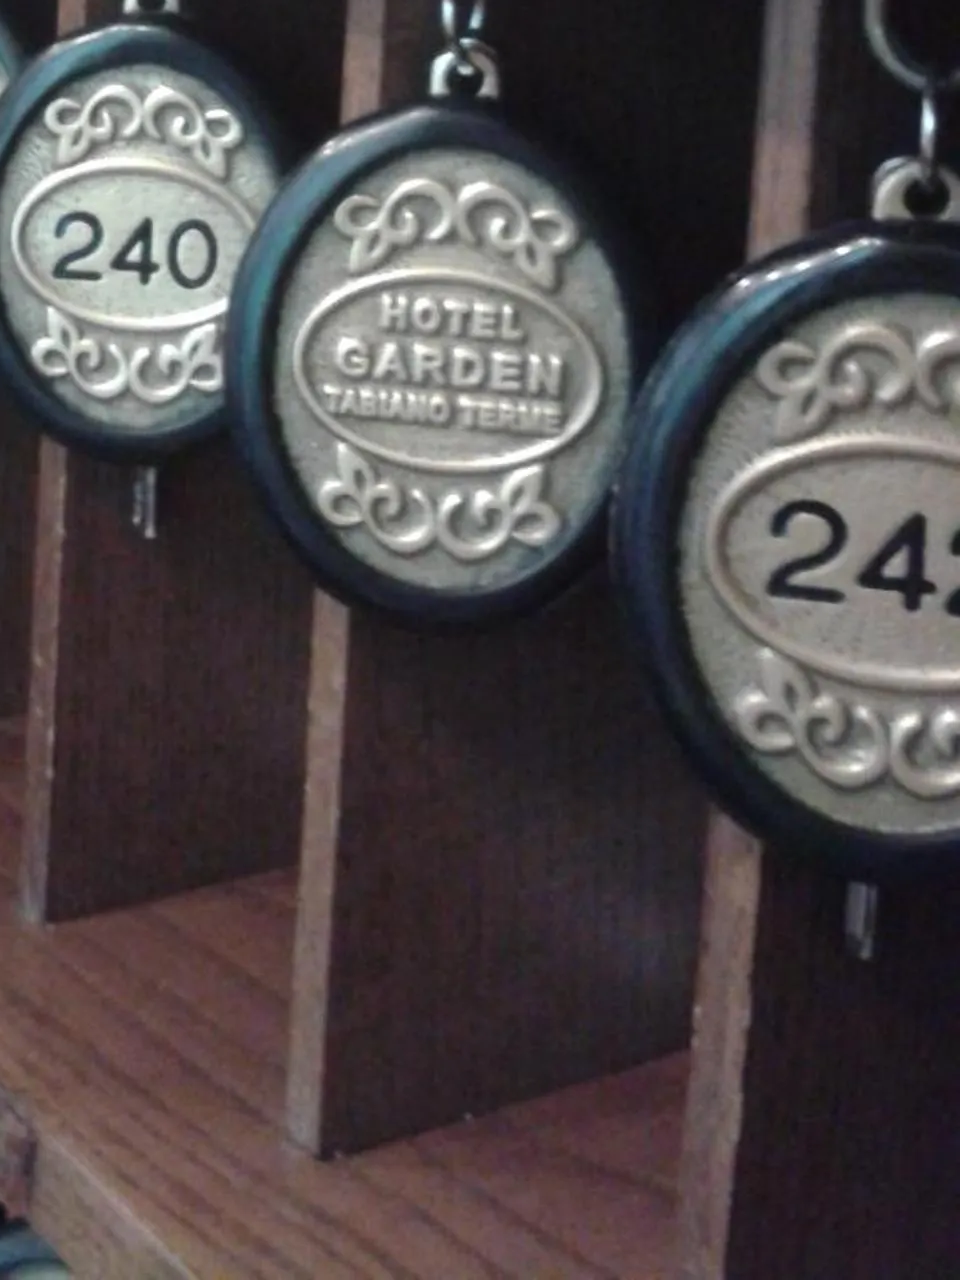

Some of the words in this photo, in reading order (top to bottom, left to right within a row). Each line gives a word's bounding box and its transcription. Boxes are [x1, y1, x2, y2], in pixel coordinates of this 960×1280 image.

[52, 211, 218, 290] 240
[378, 292, 524, 340] HOTEL
[336, 335, 564, 397] GARDEN
[766, 499, 960, 618] 24
